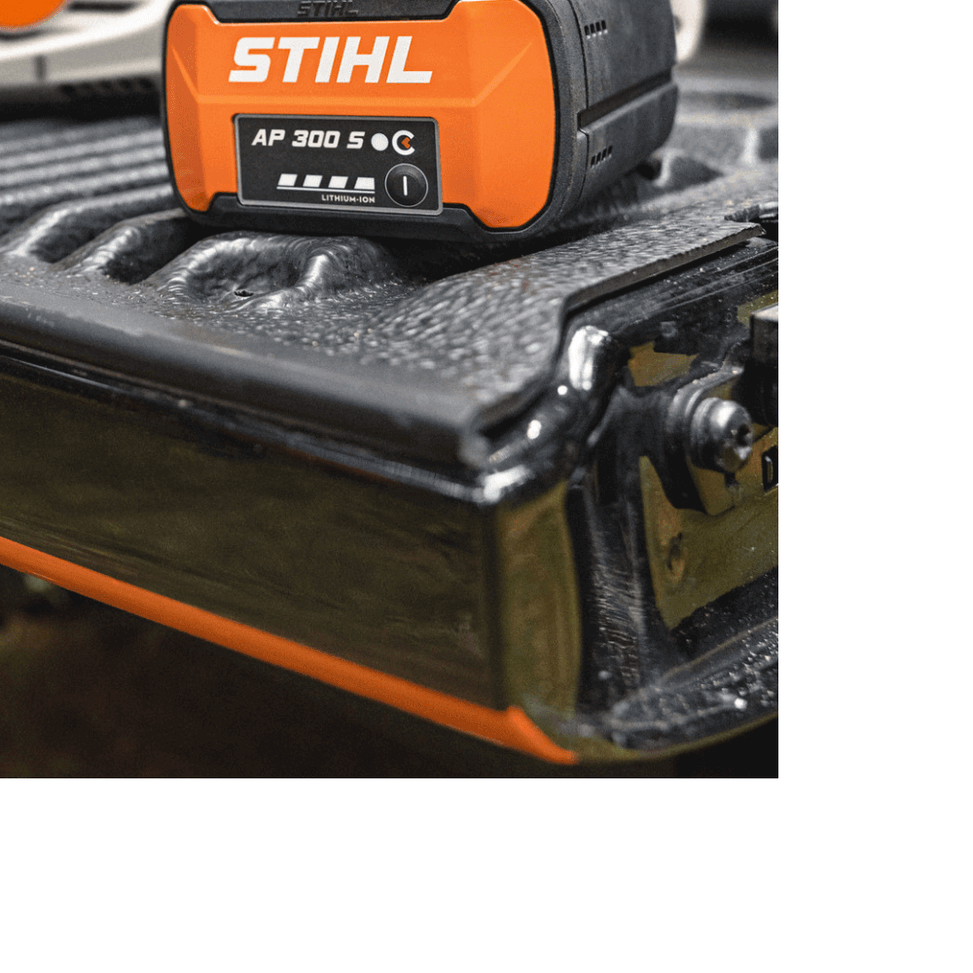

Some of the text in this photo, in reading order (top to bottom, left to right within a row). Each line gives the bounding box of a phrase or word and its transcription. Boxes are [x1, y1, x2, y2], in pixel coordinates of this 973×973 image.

[297, 0, 359, 17] STIHL
[229, 35, 433, 84] STIHL
[251, 128, 286, 147] AP
[291, 129, 341, 149] 300
[346, 130, 366, 150] S
[321, 194, 376, 204] LITHIUM-ION
